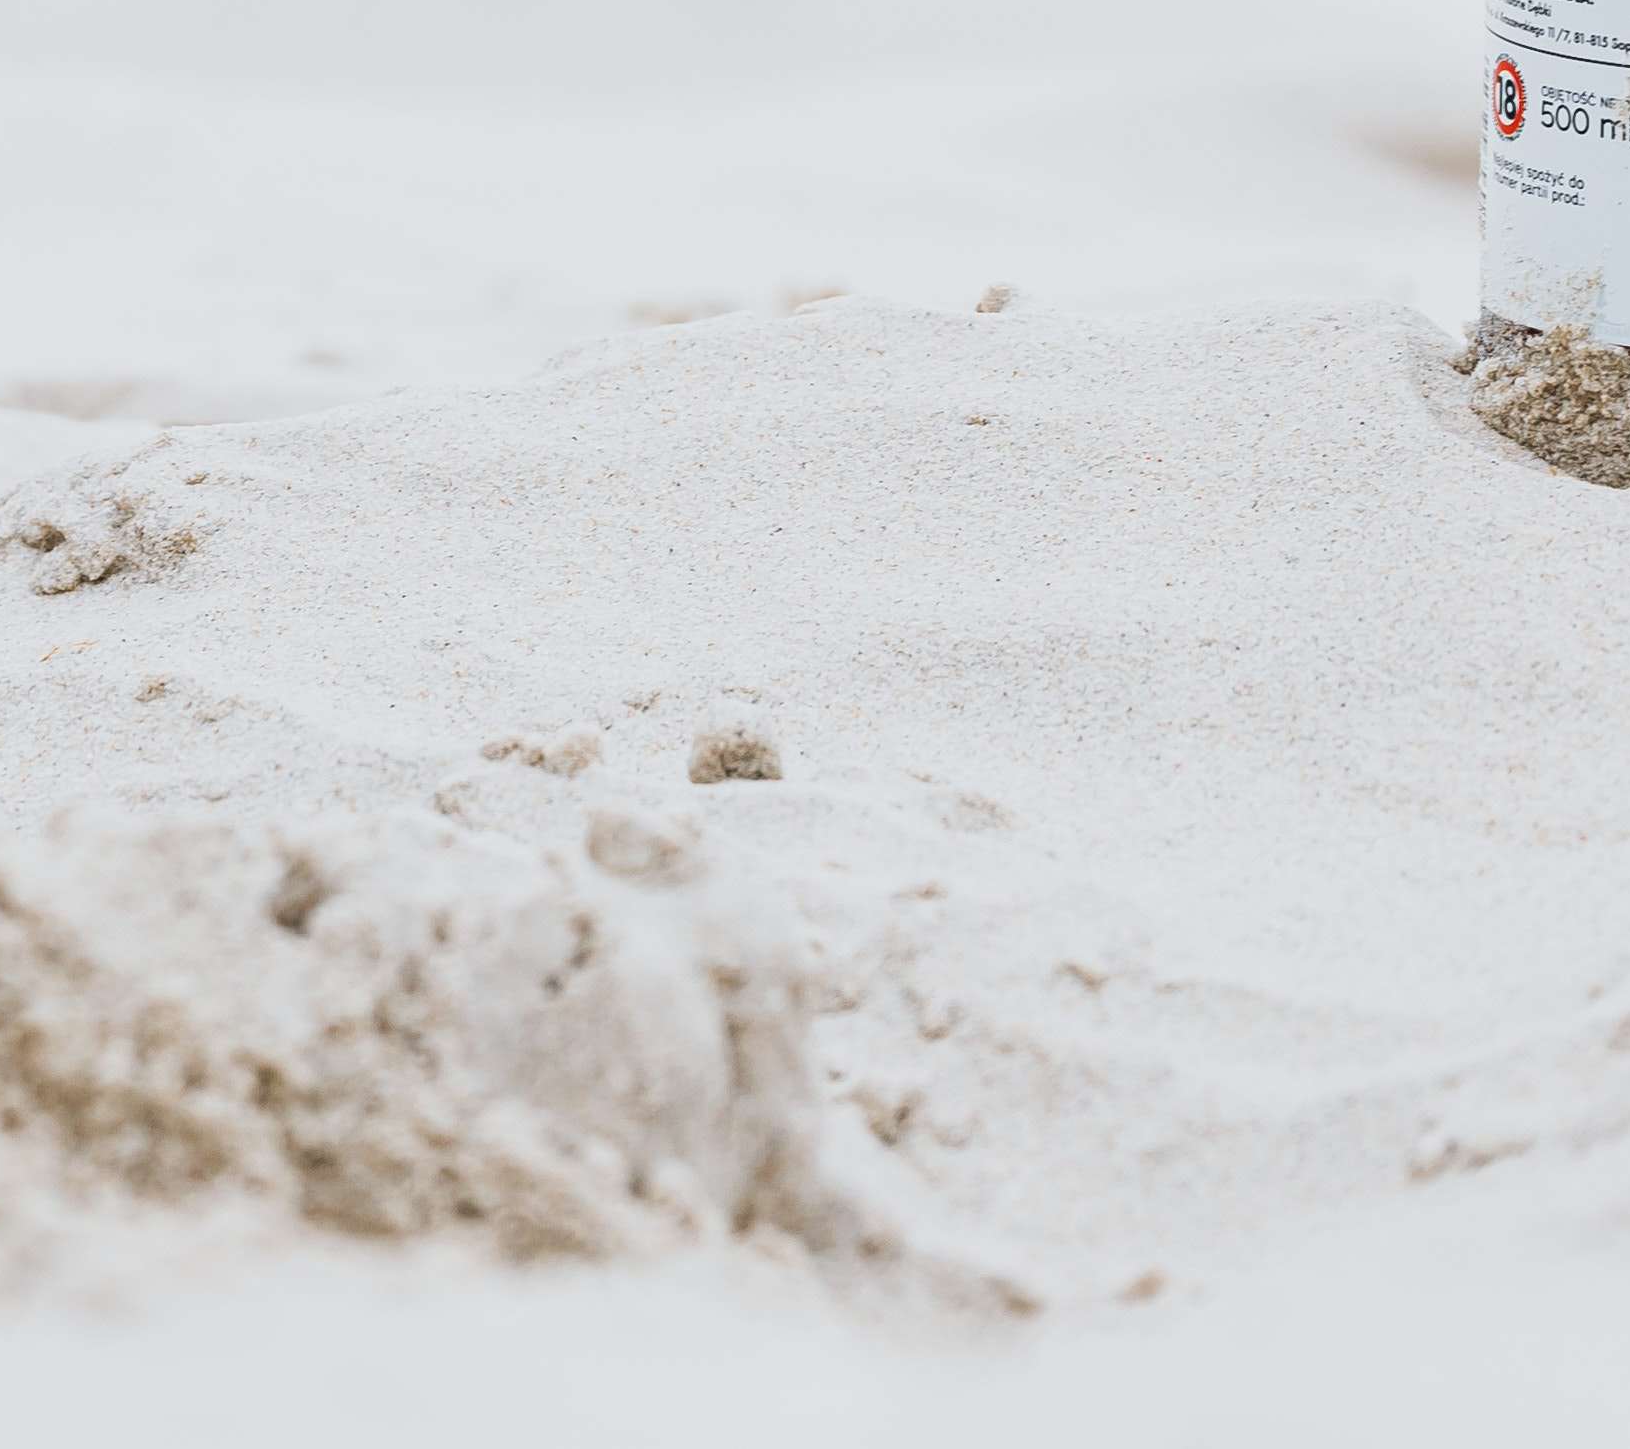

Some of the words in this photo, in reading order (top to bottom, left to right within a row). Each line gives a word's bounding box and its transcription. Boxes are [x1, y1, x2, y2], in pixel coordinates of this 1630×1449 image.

[1497, 75, 1517, 120] 18
[1540, 100, 1590, 135] 500
[1526, 167, 1564, 187] spożyć
[1568, 175, 1585, 190] do
